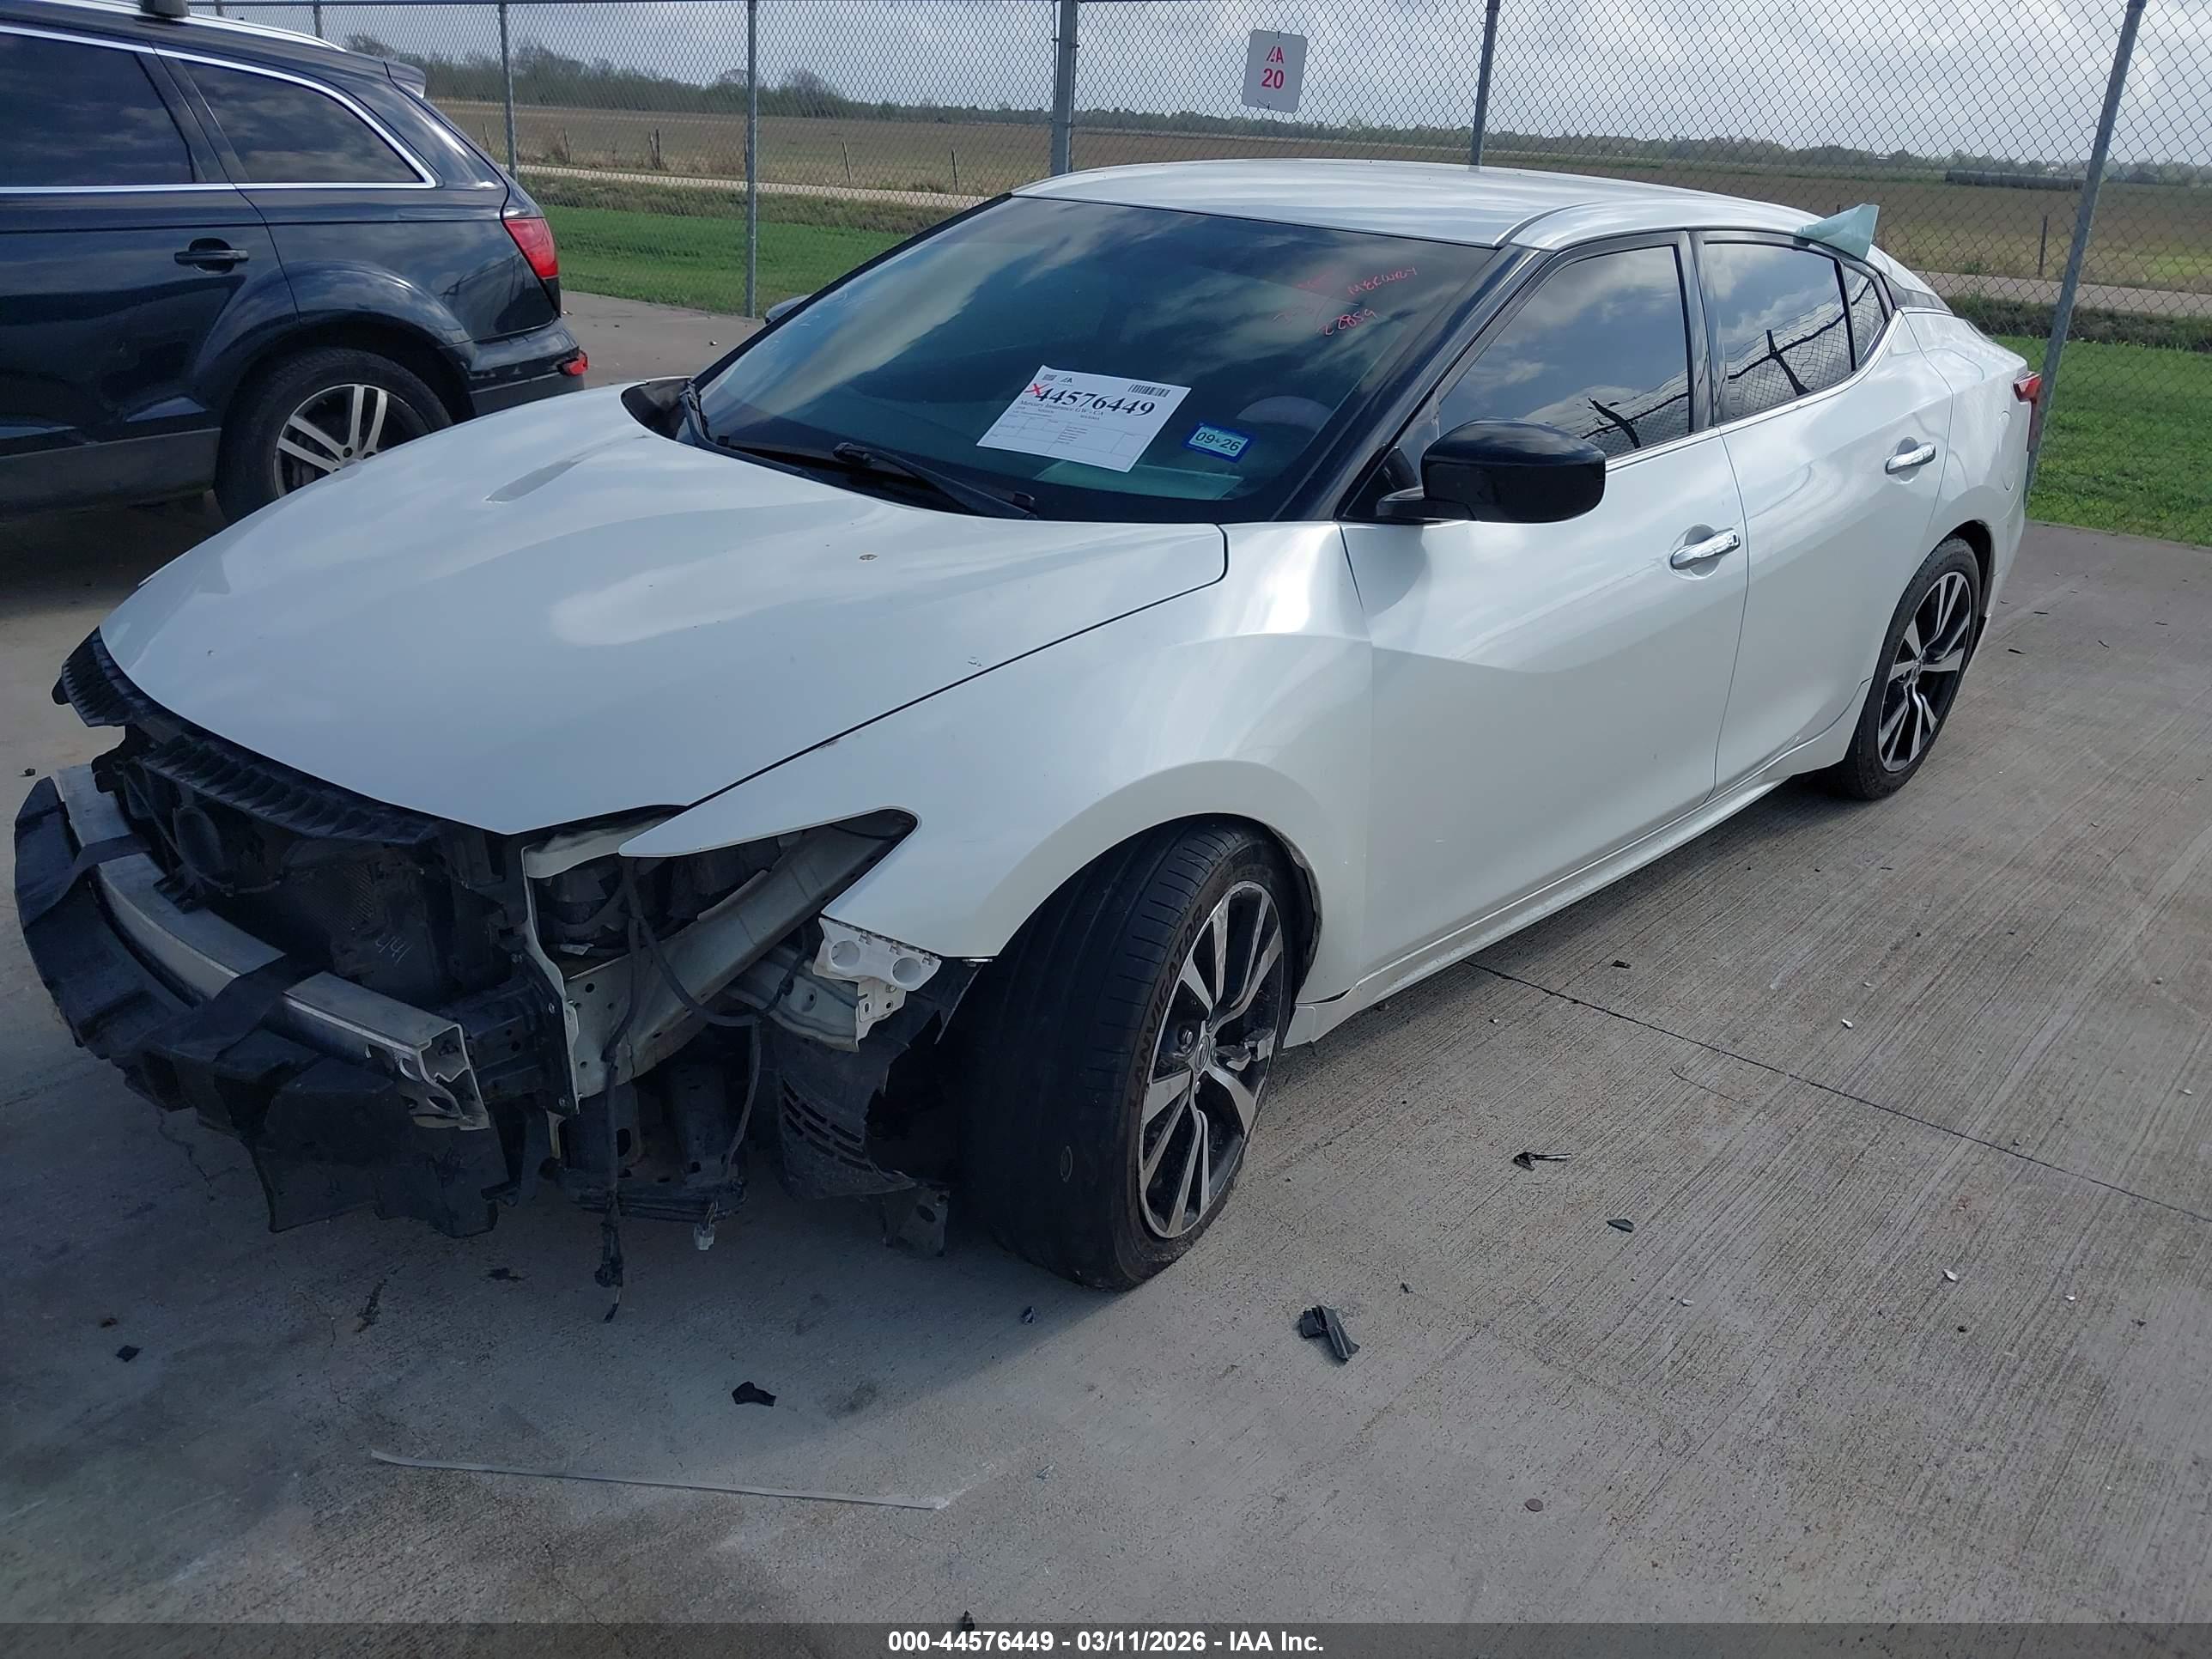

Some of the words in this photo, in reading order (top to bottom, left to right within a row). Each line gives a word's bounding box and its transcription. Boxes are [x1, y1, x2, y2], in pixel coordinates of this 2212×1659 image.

[1261, 68, 1285, 89] 20
[1034, 387, 1155, 416] 44576449
[1128, 903, 1204, 1107] LANVIGATOR
